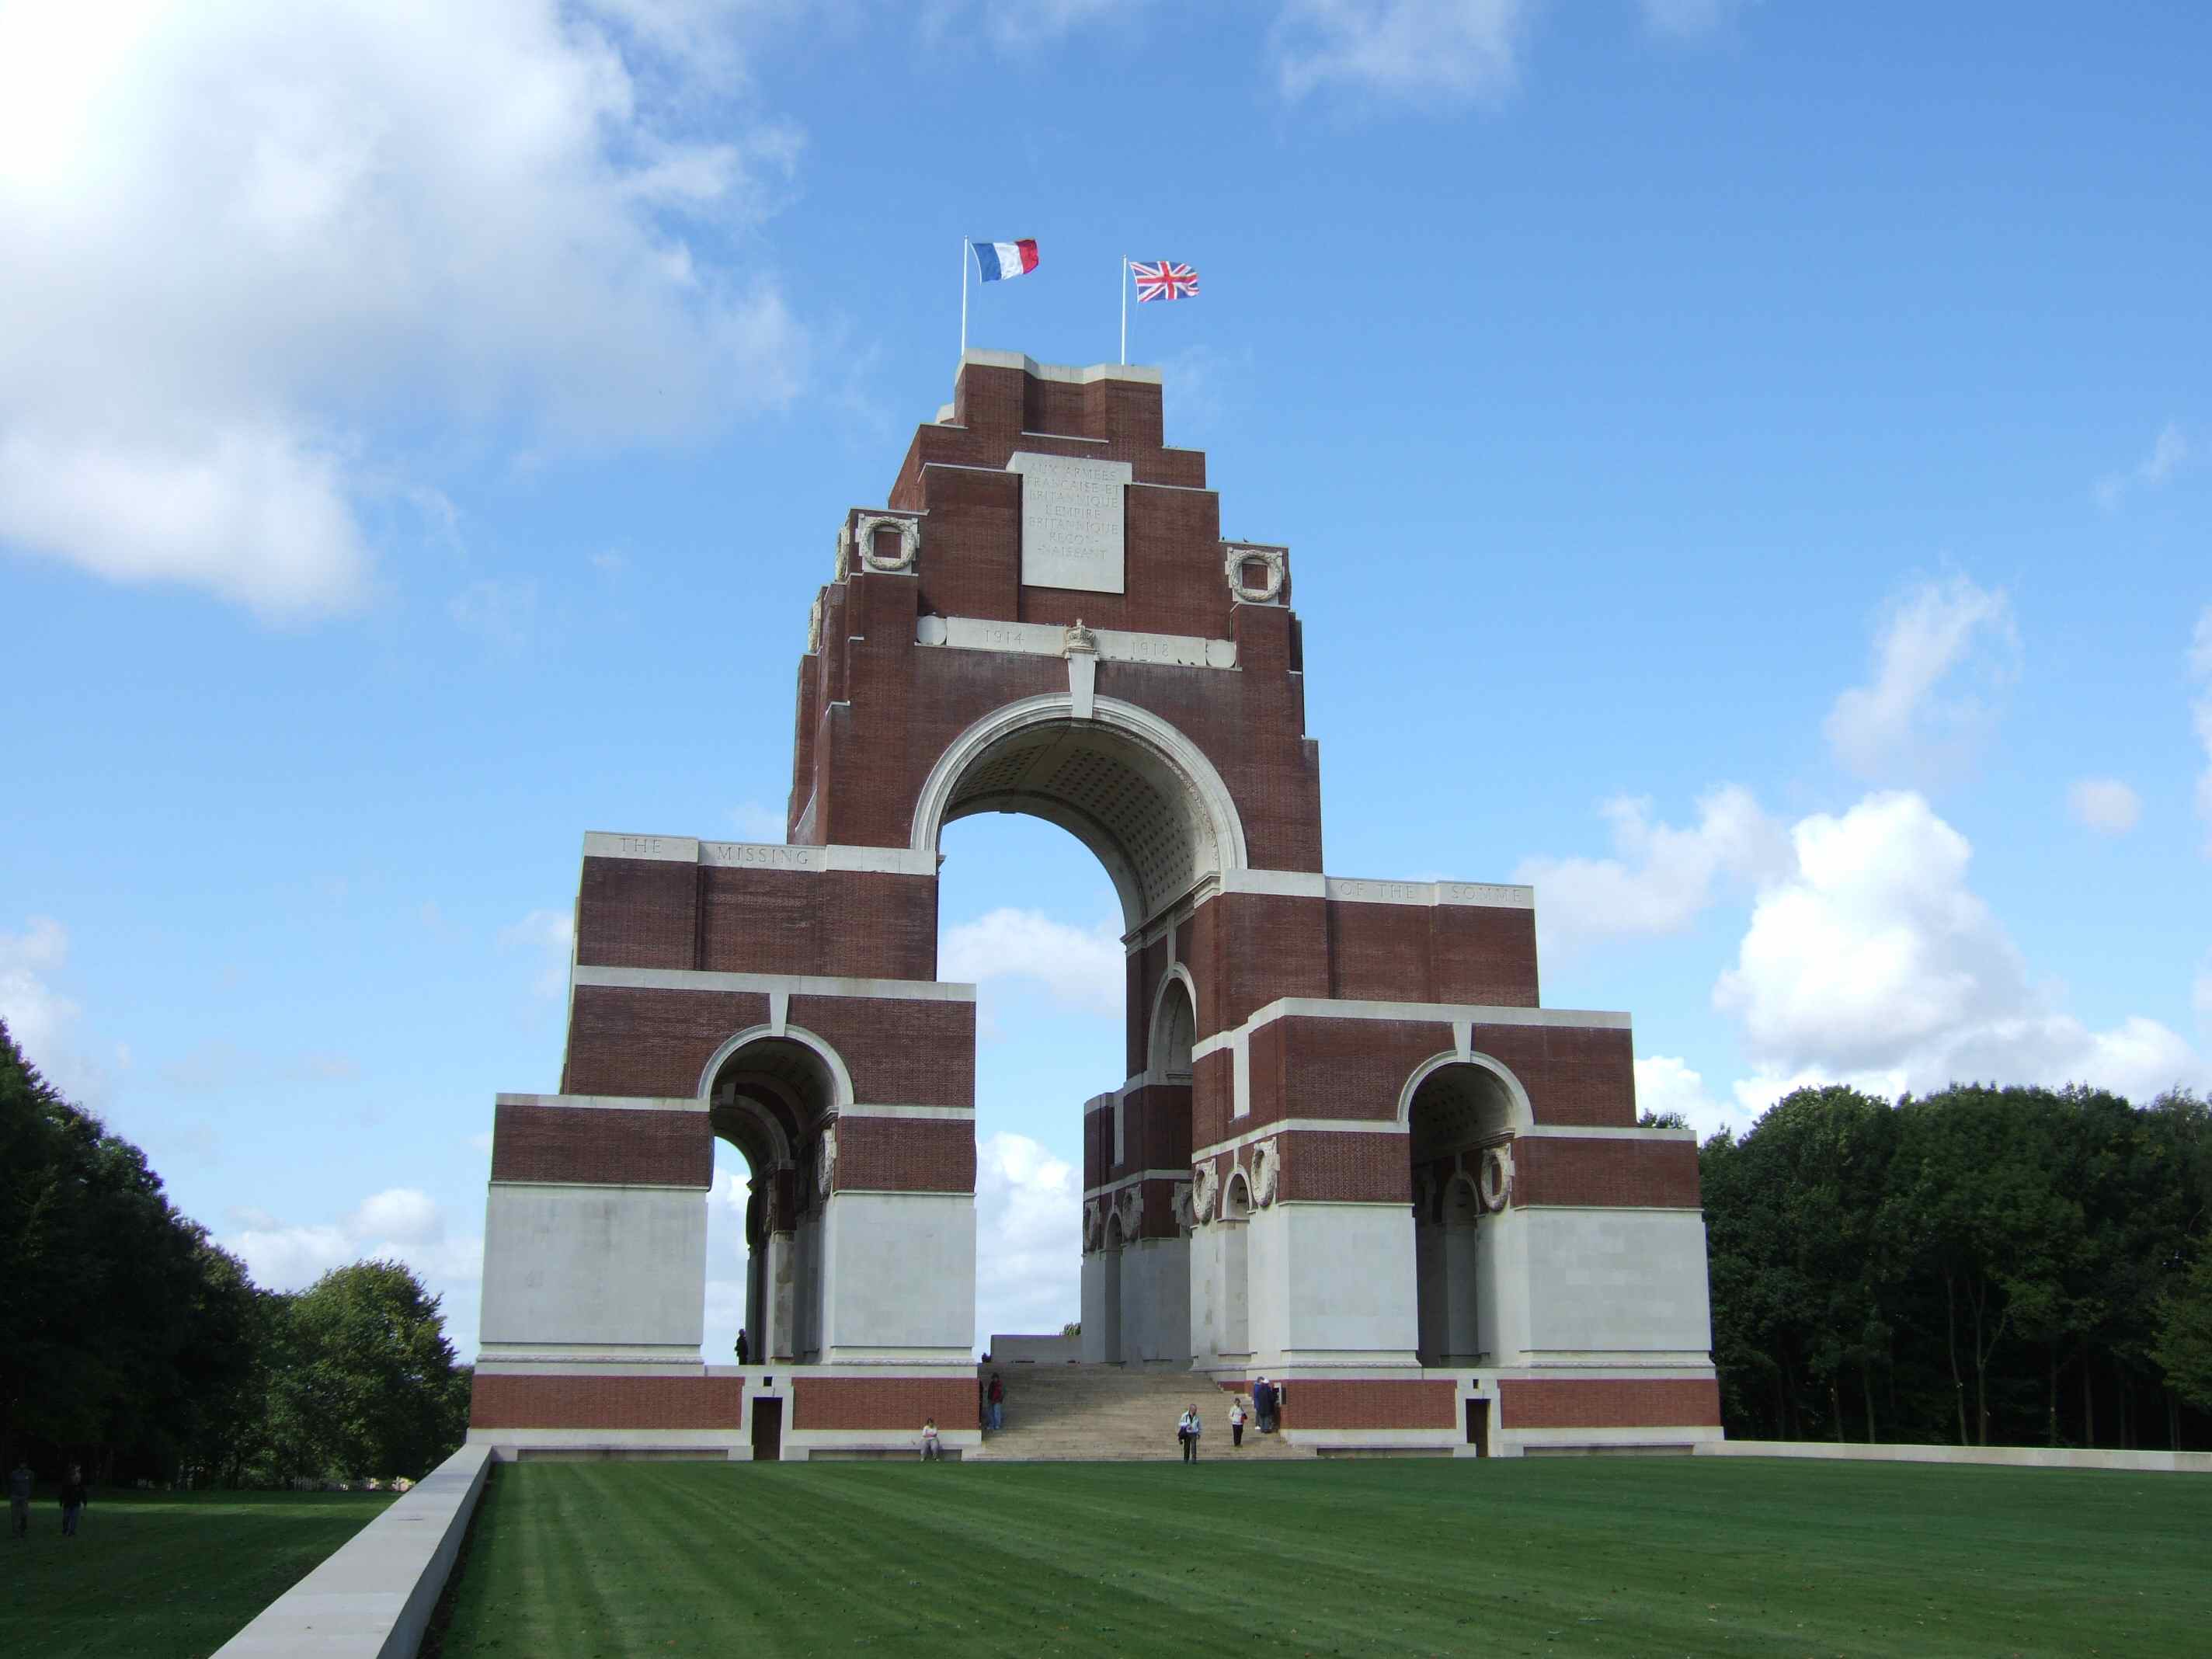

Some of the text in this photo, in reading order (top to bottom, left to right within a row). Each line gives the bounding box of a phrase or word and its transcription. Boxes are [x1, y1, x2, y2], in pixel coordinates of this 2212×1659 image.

[1105, 485, 1121, 495] ET
[985, 629, 1026, 645] 1914
[1132, 641, 1169, 657] 1918
[620, 837, 808, 864] THE MISSING
[1341, 882, 1522, 903] OF THE SOMME
